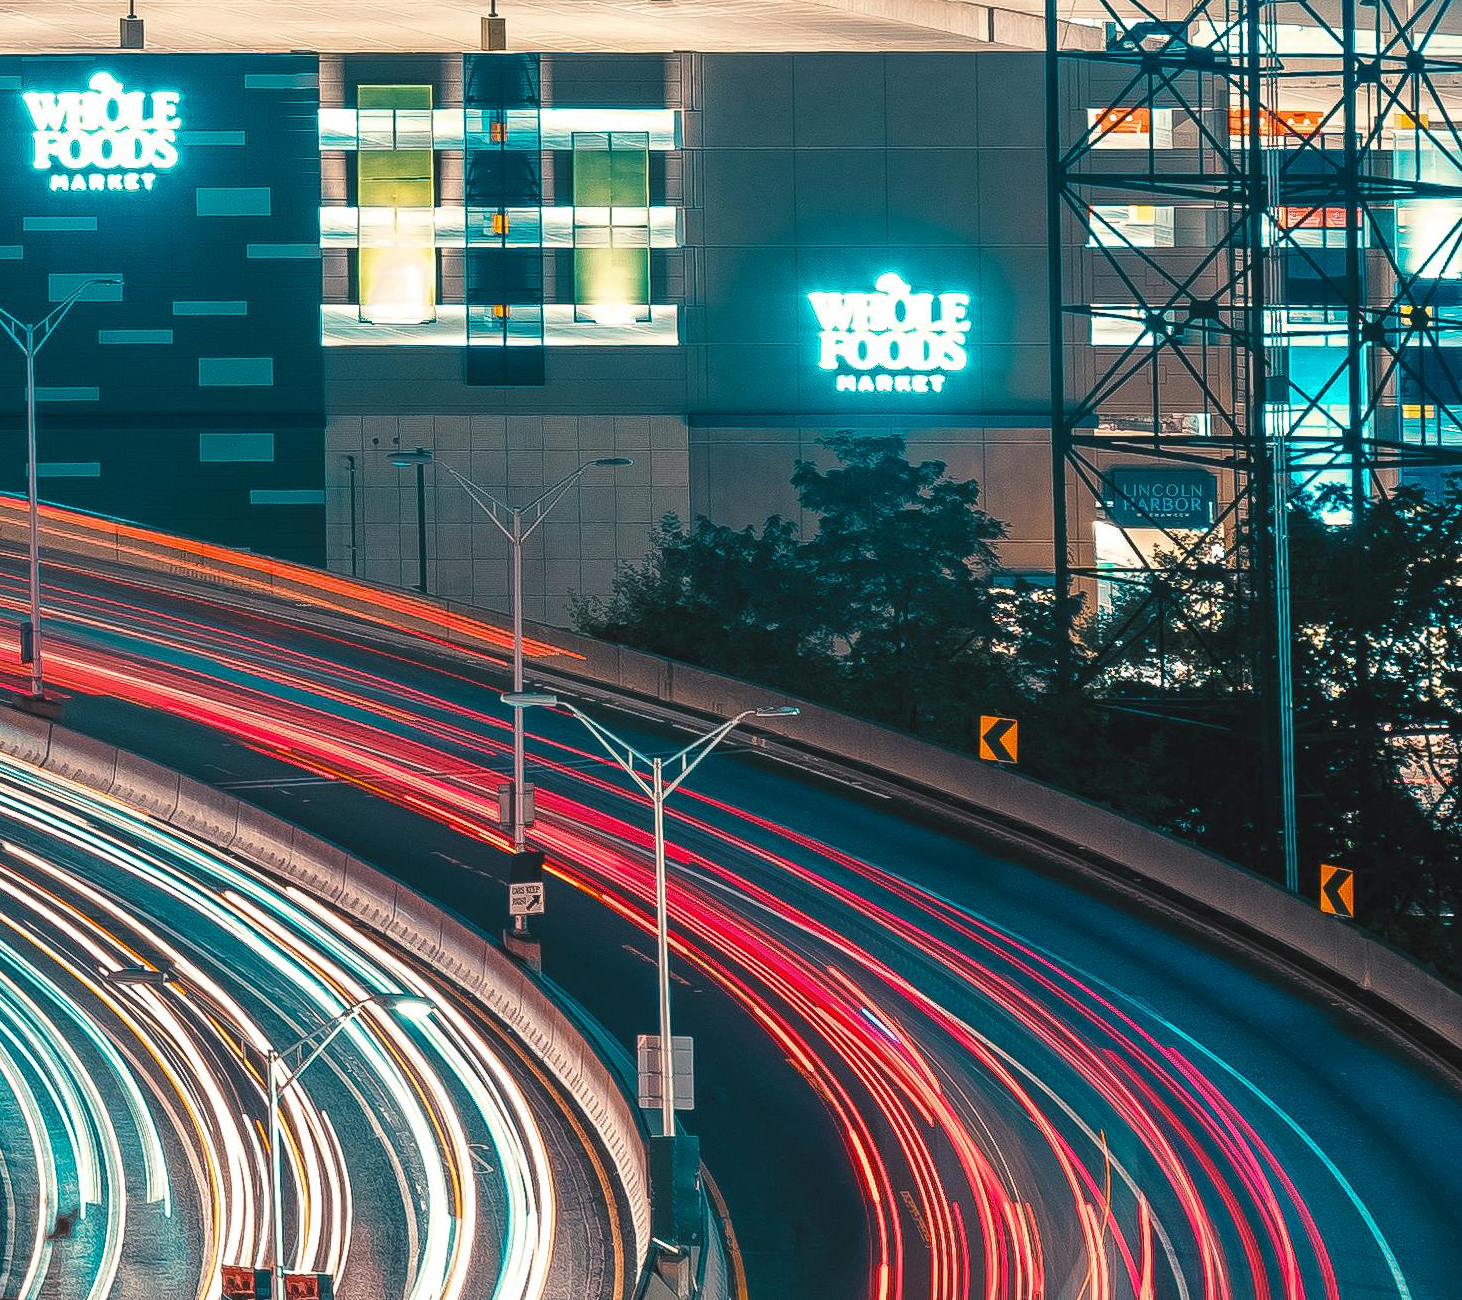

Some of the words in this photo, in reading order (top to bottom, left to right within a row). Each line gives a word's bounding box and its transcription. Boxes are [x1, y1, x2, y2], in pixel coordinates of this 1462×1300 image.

[22, 91, 181, 130] WHOLE
[33, 130, 179, 169] FOODS
[50, 173, 156, 191] MARKET
[807, 292, 971, 331] WHOLE
[818, 331, 967, 370] FOODS
[836, 374, 946, 392] MARKET
[1123, 483, 1203, 497] LINCOLN
[1123, 497, 1202, 512] HARBOR
